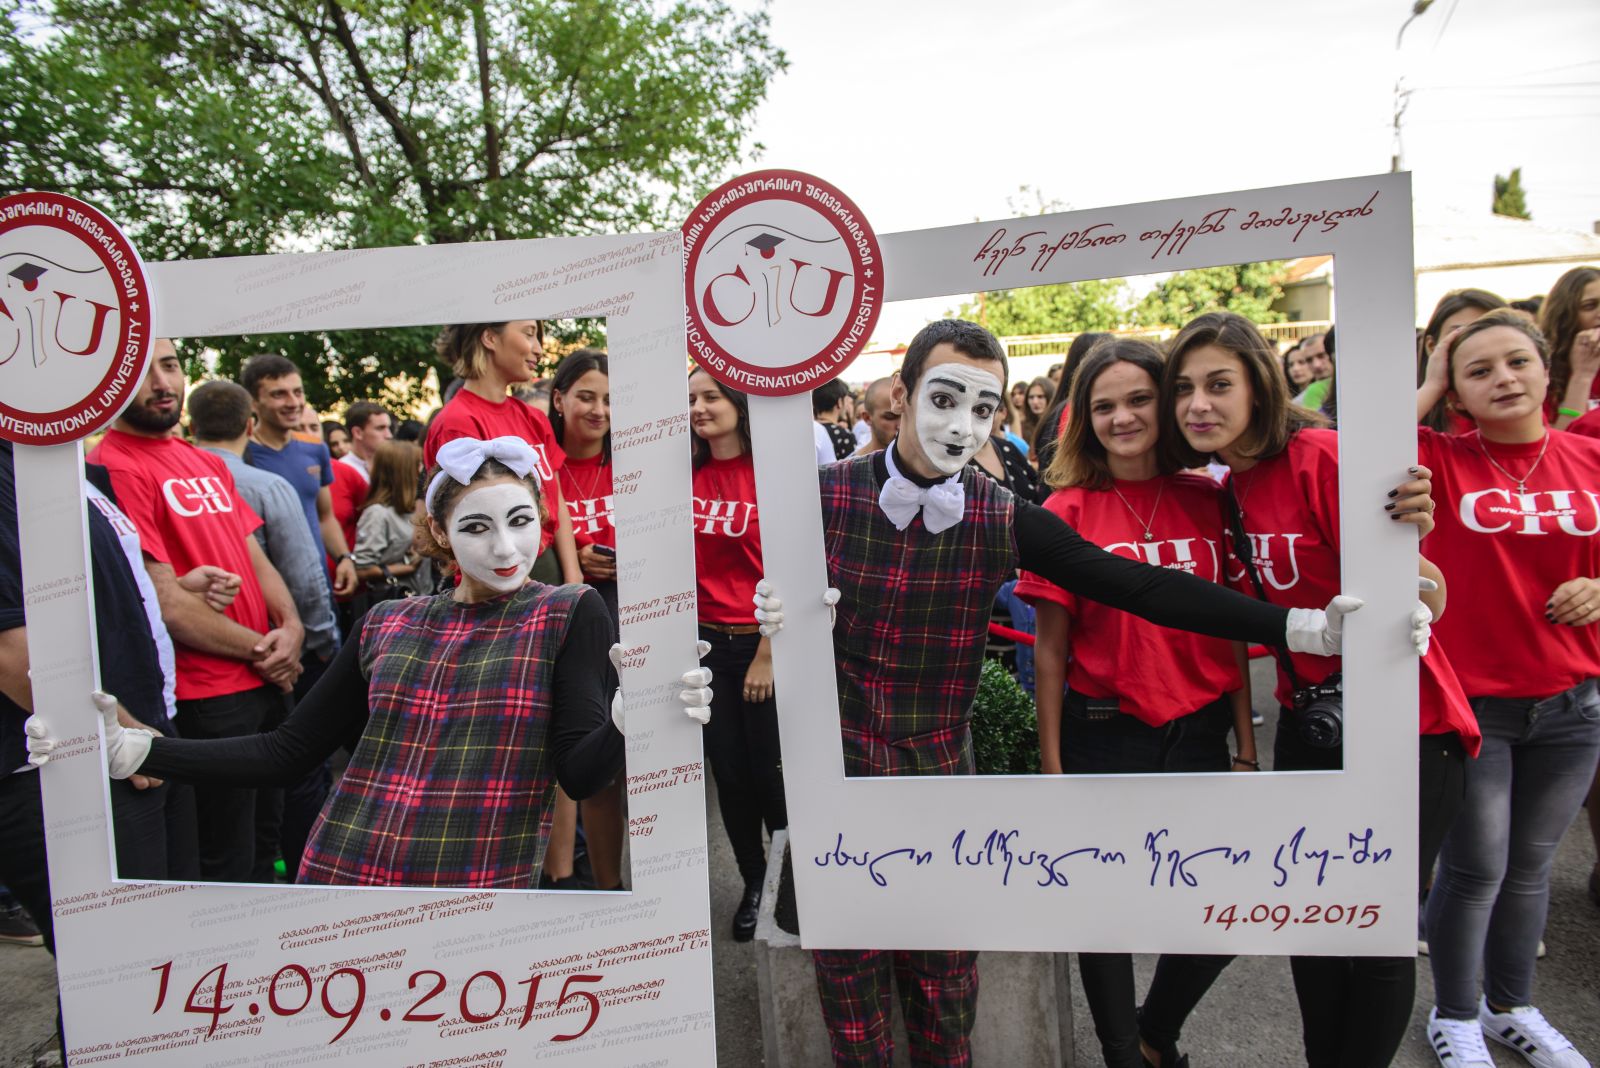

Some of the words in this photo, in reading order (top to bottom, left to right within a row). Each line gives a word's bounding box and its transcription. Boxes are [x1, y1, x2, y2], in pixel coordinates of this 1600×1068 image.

[805, 184, 874, 267] უნივერსიტეტი
[67, 208, 139, 298] უნივერსიტეტი
[494, 281, 559, 305] Caucasus
[564, 250, 655, 285] International
[726, 358, 834, 389] INTERNATIONAL
[830, 283, 875, 364] UNIVERSITY
[98, 318, 142, 408] UNIVERSITY
[162, 477, 233, 517] CIU
[1459, 487, 1600, 537] CIU
[53, 900, 108, 918] Caucasus
[110, 885, 186, 907] International
[278, 923, 330, 941] კავკასიის
[332, 906, 416, 930] საერთაშორისო
[1203, 904, 1382, 932] 14.09.2015
[280, 933, 338, 951] Caucasus
[342, 912, 424, 939] International
[429, 901, 495, 921] University
[587, 935, 674, 959] საერთაშორისო
[596, 942, 685, 968] International
[151, 960, 604, 1045] 14.09.2015
[439, 1020, 501, 1040] Caucasus
[68, 1050, 121, 1068] Caucasus
[124, 1038, 199, 1059] International
